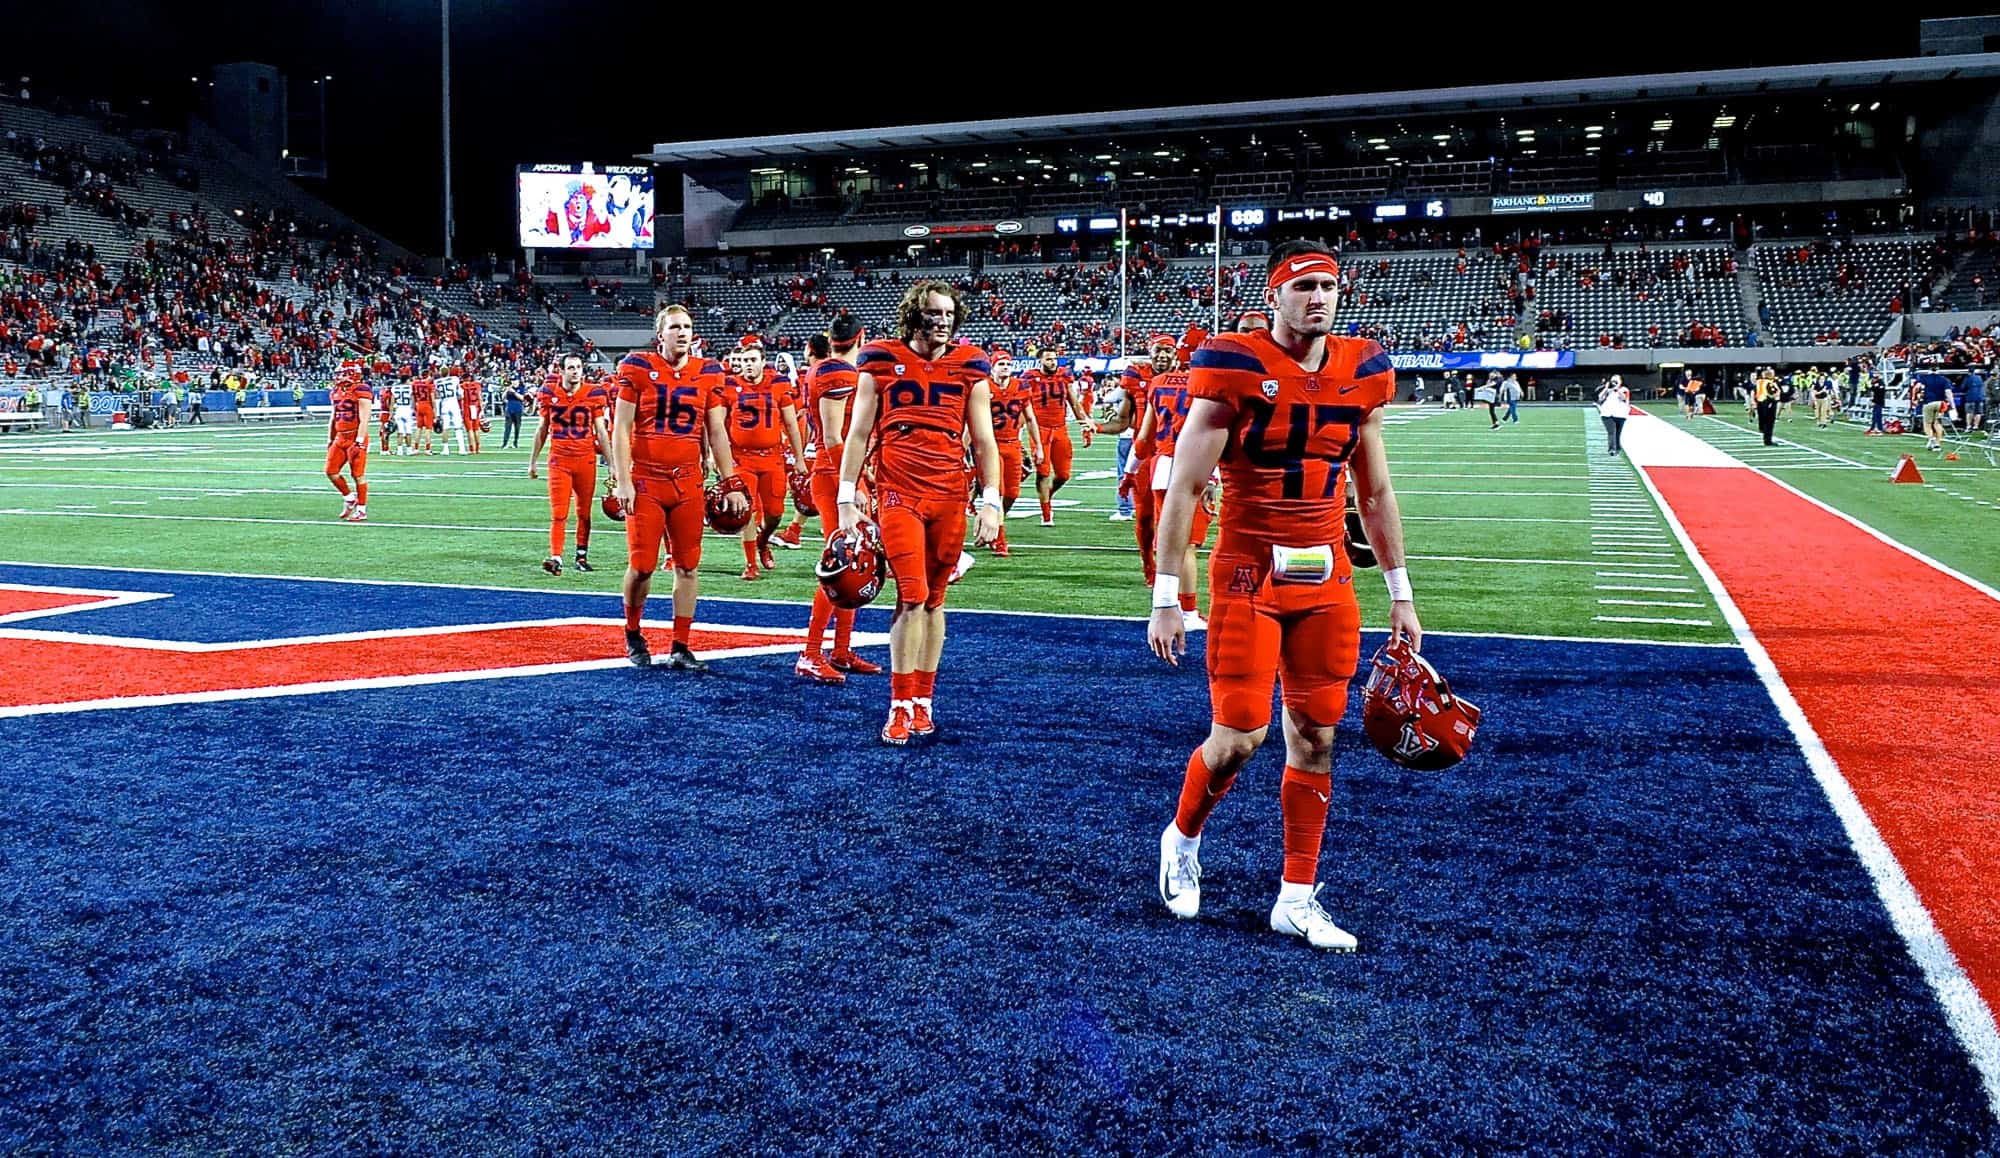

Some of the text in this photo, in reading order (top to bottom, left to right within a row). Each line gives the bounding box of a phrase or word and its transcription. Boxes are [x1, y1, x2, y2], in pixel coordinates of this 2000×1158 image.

[533, 163, 648, 174] ARIZONA WILDCATS
[1493, 197, 1536, 207] FARHANG
[1547, 194, 1593, 204] MEDCOFF
[1643, 192, 1664, 206] 40
[1328, 206, 1339, 220] 2
[1426, 200, 1444, 217] 15
[1057, 218, 1078, 231] 44
[1151, 214, 1161, 227] 2
[1178, 213, 1188, 226] 2
[1231, 208, 1264, 226] 0:00
[394, 390, 410, 406] 26
[437, 382, 455, 400] 35
[1041, 381, 1066, 408] 14
[655, 384, 698, 434] 16
[738, 392, 773, 429] 51
[551, 405, 590, 440] 30
[1243, 399, 1362, 499] 47
